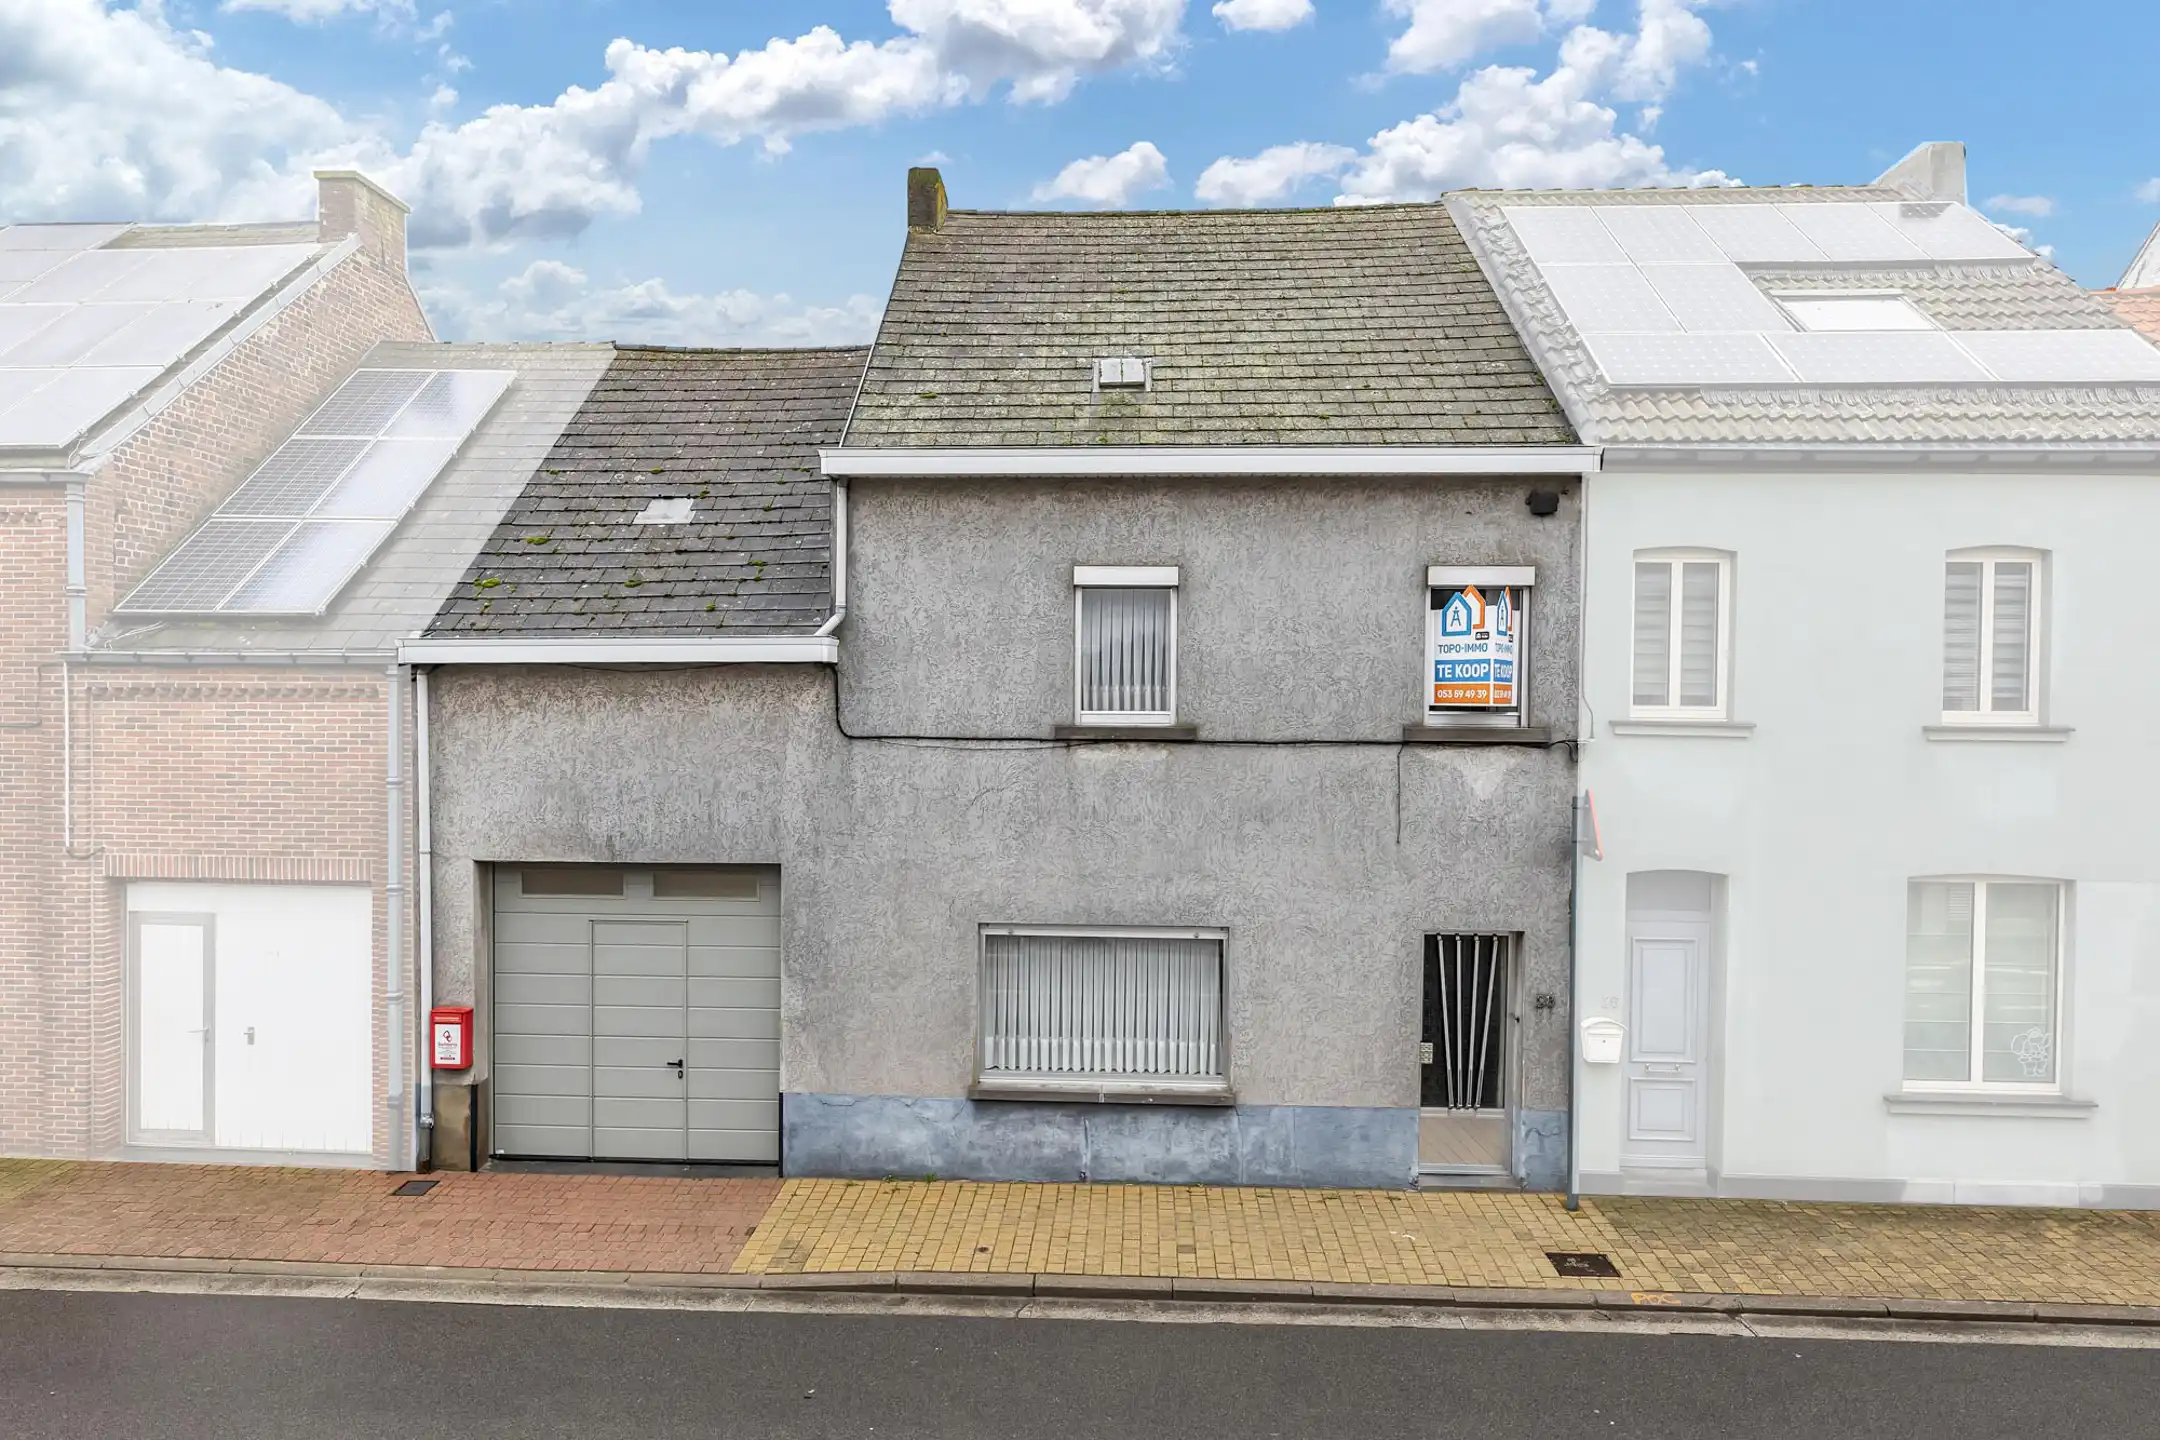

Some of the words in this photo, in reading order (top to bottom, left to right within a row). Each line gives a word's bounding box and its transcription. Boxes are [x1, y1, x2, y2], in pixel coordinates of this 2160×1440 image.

[1438, 643, 1488, 654] TOPO-IMMO
[1437, 664, 1452, 678] TE
[1455, 663, 1489, 678] KOOP
[1437, 690, 1453, 698] 053
